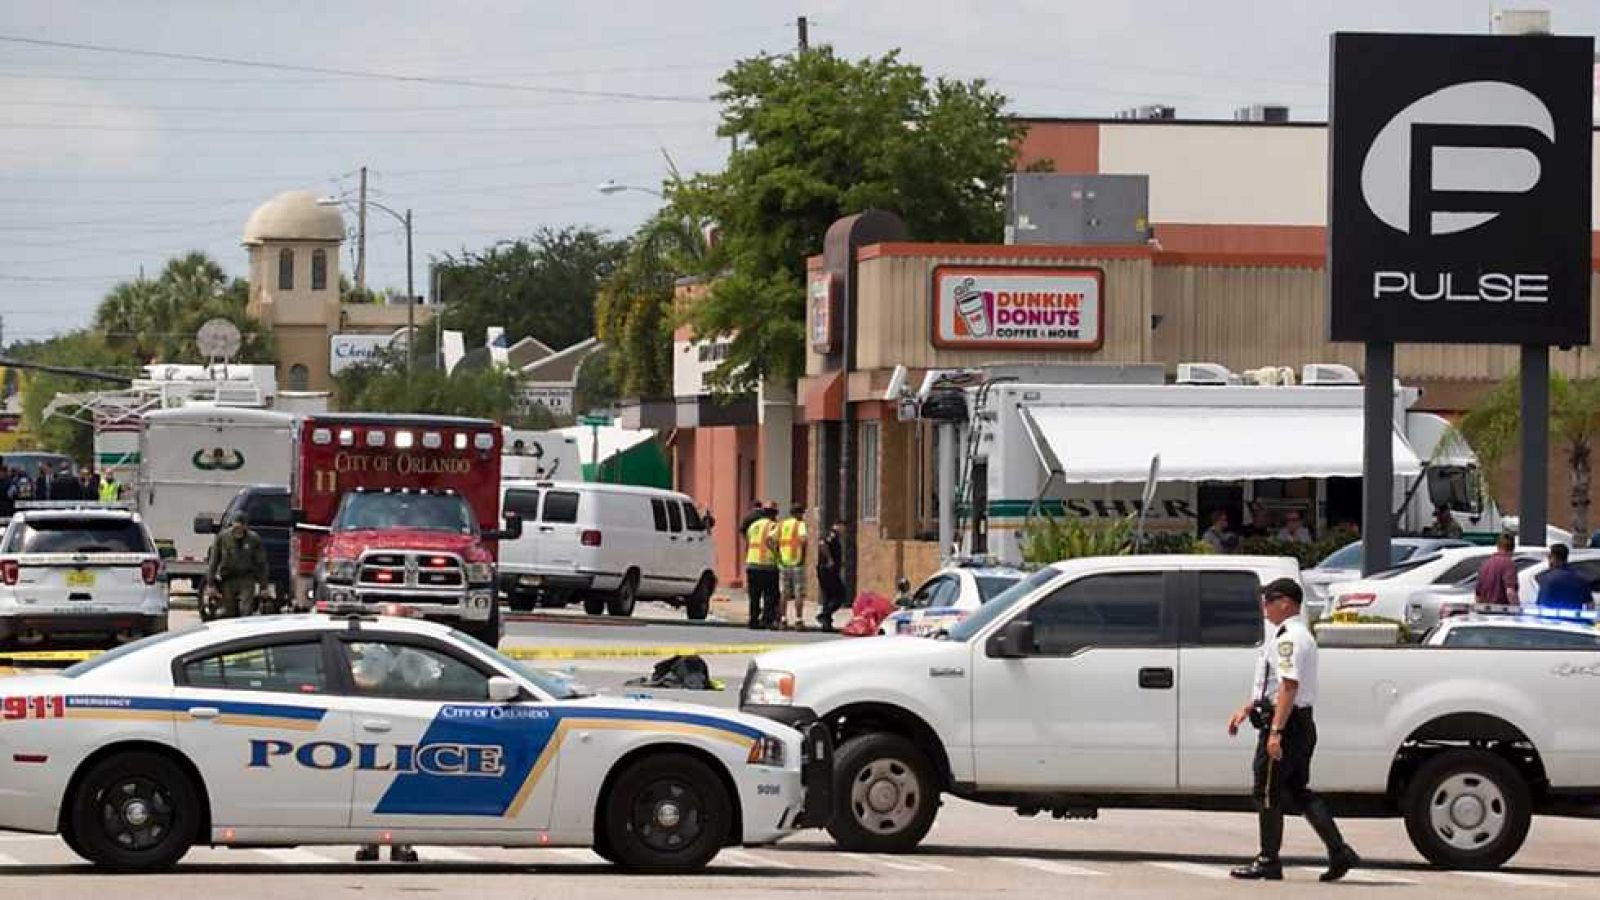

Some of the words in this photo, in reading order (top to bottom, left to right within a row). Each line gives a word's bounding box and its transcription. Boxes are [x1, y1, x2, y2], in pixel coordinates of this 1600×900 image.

[1373, 271, 1549, 302] PULSE
[997, 292, 1084, 307] DUNKIN'
[997, 309, 1080, 325] DONUTS
[996, 328, 1038, 338] COFFEE
[1047, 328, 1080, 338] MORE
[396, 453, 470, 474] ORLANDO
[315, 470, 337, 491] 11
[3, 695, 64, 719] 911
[68, 698, 131, 706] EMERGENCY
[247, 740, 506, 776] POLICE
